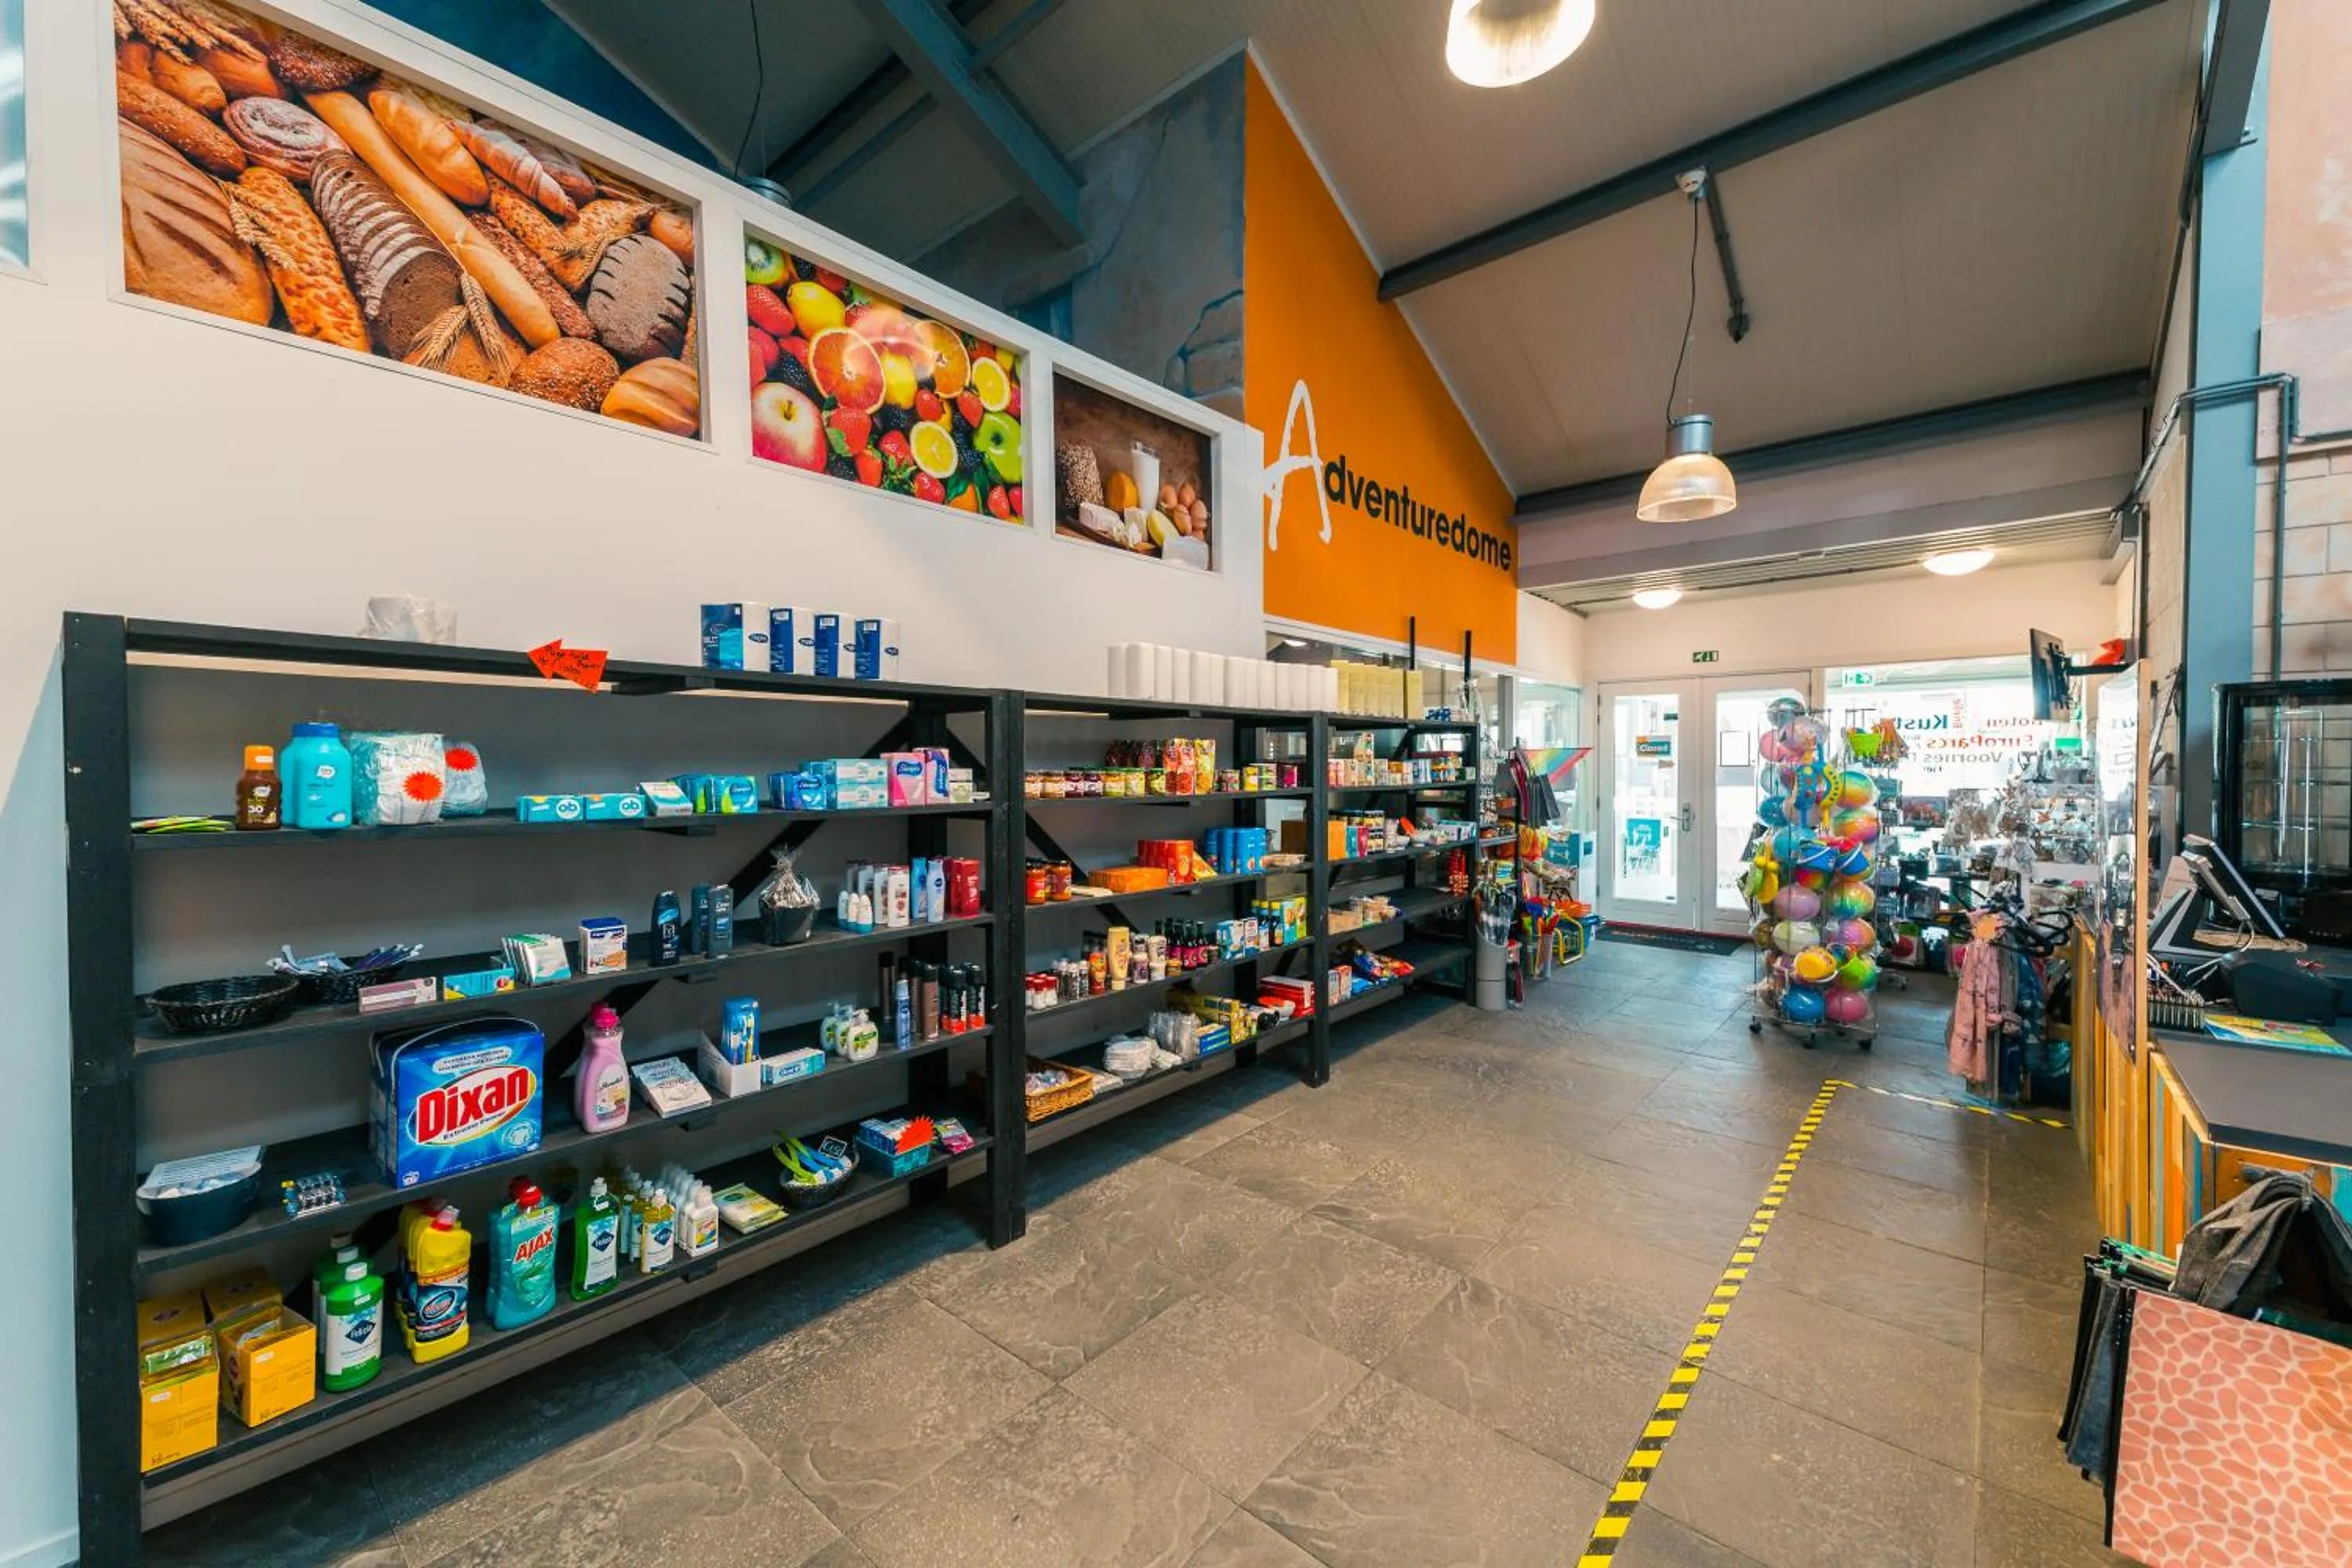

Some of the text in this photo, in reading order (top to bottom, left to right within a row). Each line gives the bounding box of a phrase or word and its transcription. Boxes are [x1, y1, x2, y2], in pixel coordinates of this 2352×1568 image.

[1261, 379, 1512, 571] Adventuredome
[416, 1067, 529, 1144] Dixan
[514, 1226, 554, 1262] AJAX
